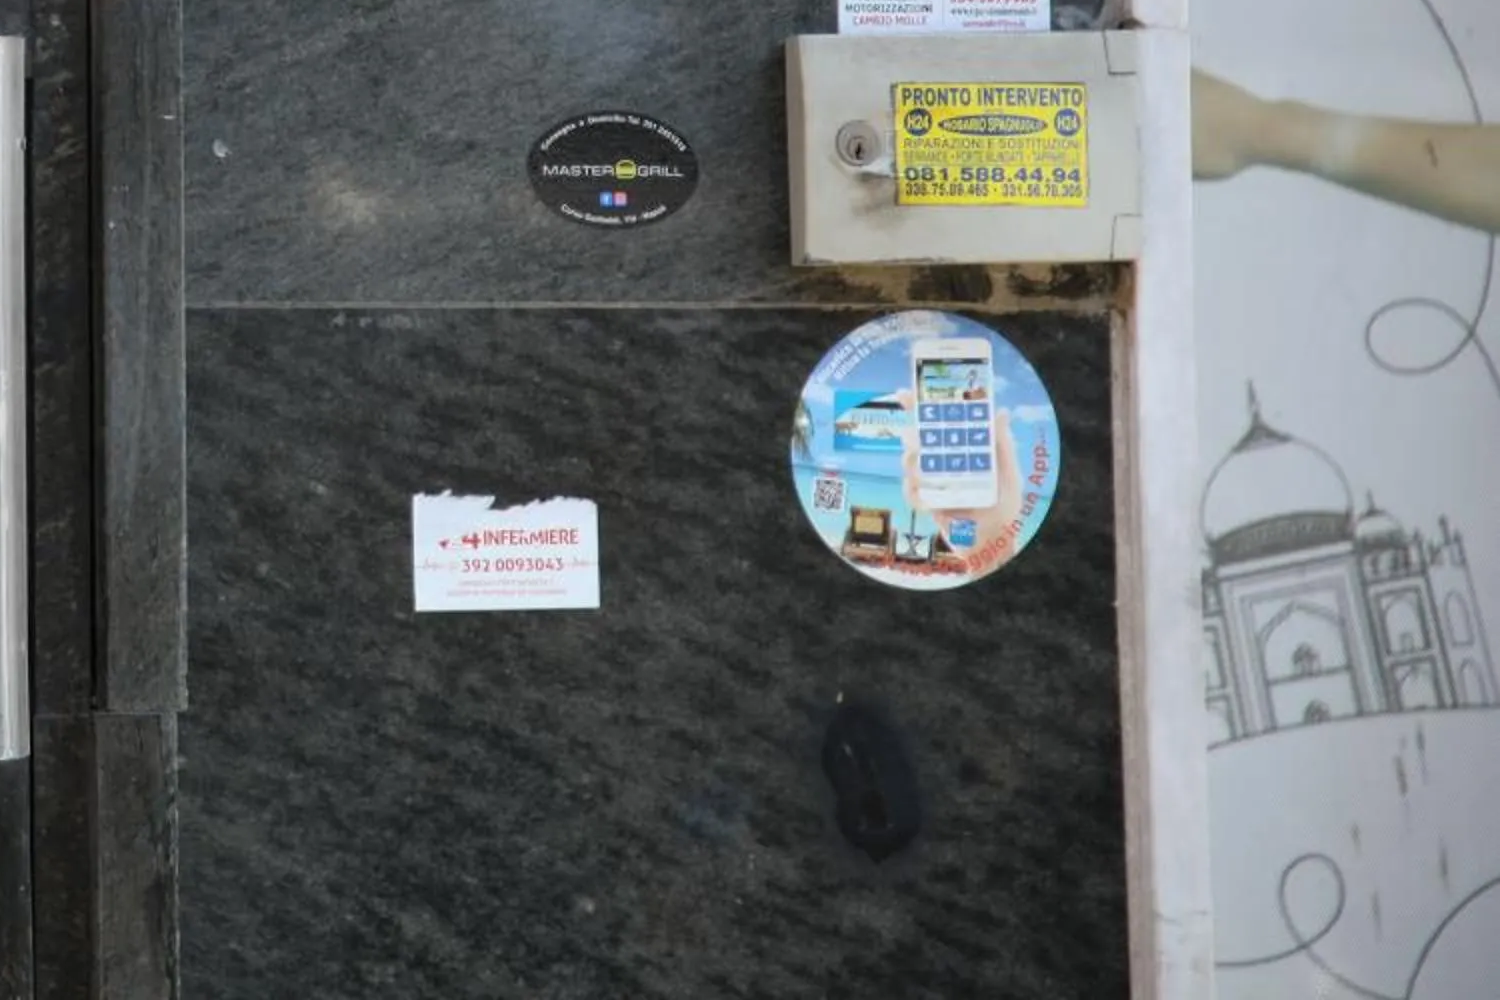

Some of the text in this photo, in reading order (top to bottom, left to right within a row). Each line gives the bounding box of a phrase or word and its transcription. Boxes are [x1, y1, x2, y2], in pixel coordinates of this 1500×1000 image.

[902, 87, 1083, 106] PRONTO INTERVENTO
[543, 165, 684, 177] MASTER GRILL
[483, 528, 580, 545] INFERMIERE
